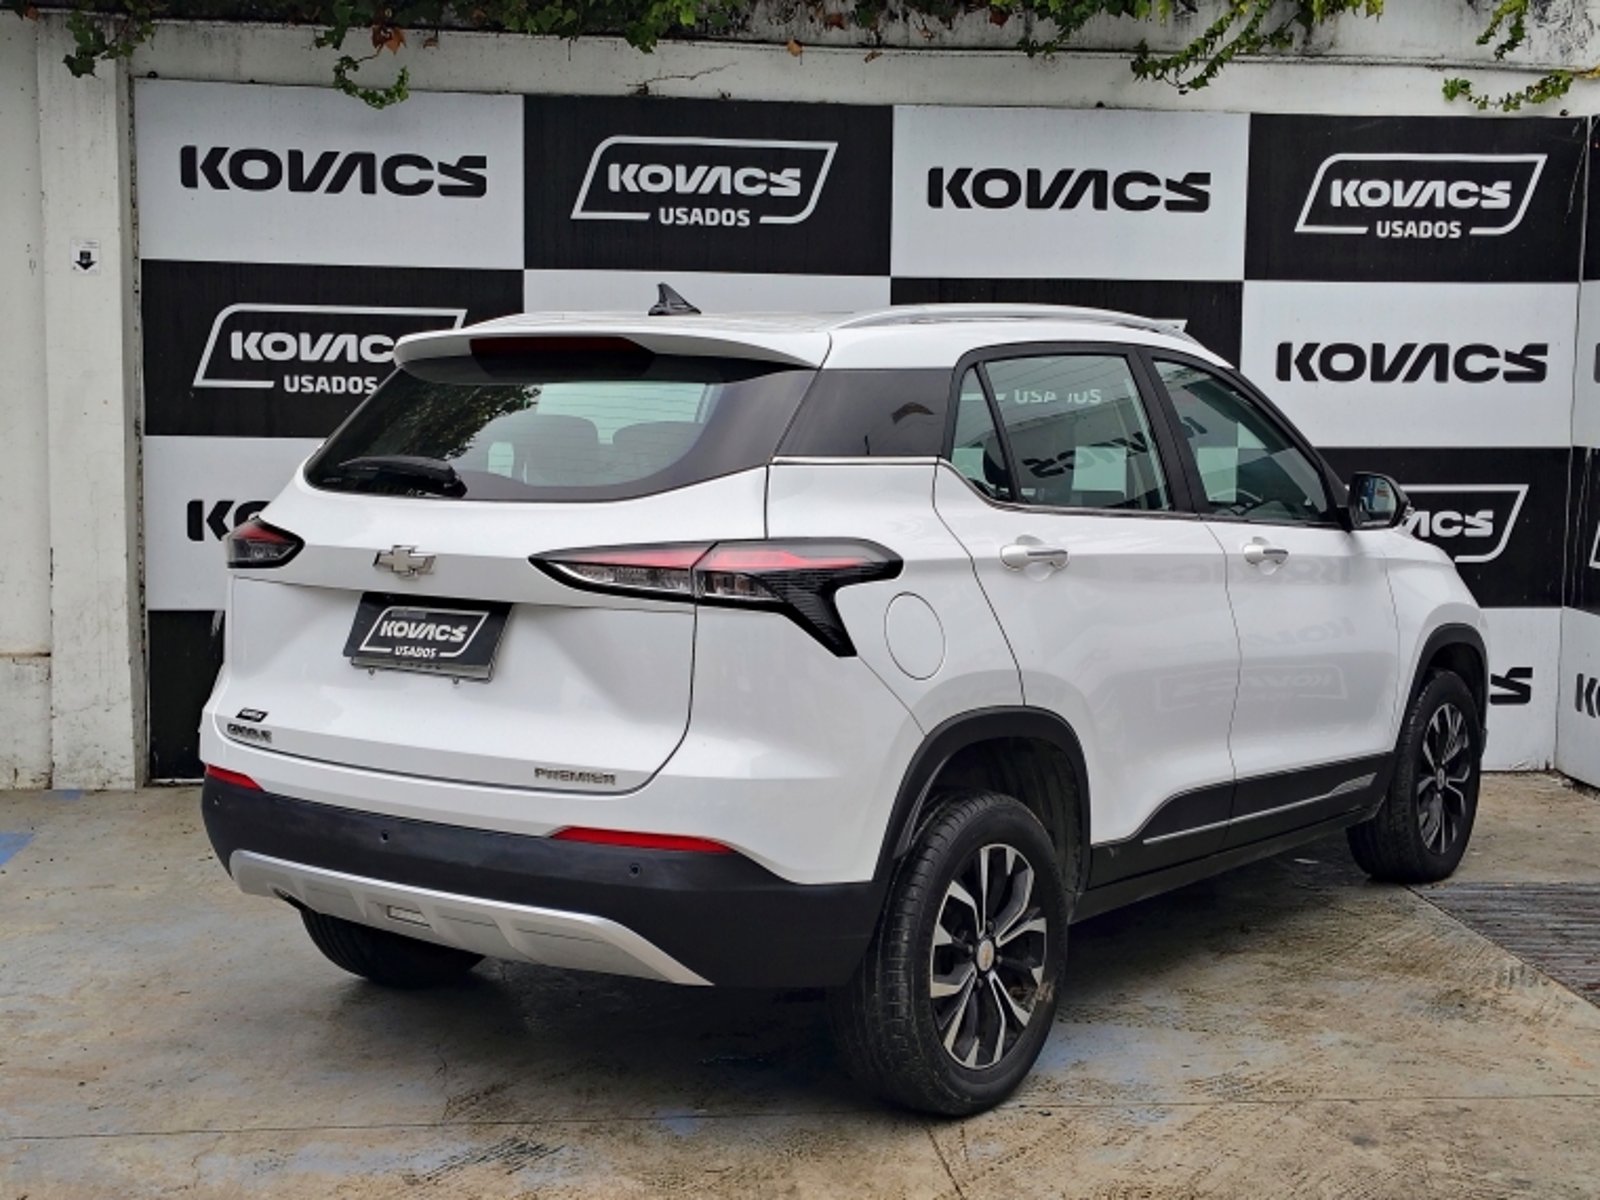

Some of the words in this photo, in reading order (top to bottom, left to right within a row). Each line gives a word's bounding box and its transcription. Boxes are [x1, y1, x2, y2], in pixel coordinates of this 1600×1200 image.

[180, 145, 488, 198] KOVACS
[607, 163, 802, 197] KOVACS
[927, 167, 1211, 213] KOVACS
[1330, 179, 1512, 209] KOVACS
[658, 207, 751, 227] USADOS
[1376, 220, 1462, 239] USADOS
[230, 331, 395, 363] KOVAC
[1275, 341, 1549, 384] KOVACS
[283, 375, 379, 395] USADOS
[379, 620, 468, 643] KOVACS
[394, 646, 437, 659] USADOS
[533, 767, 616, 786] PREMIER
